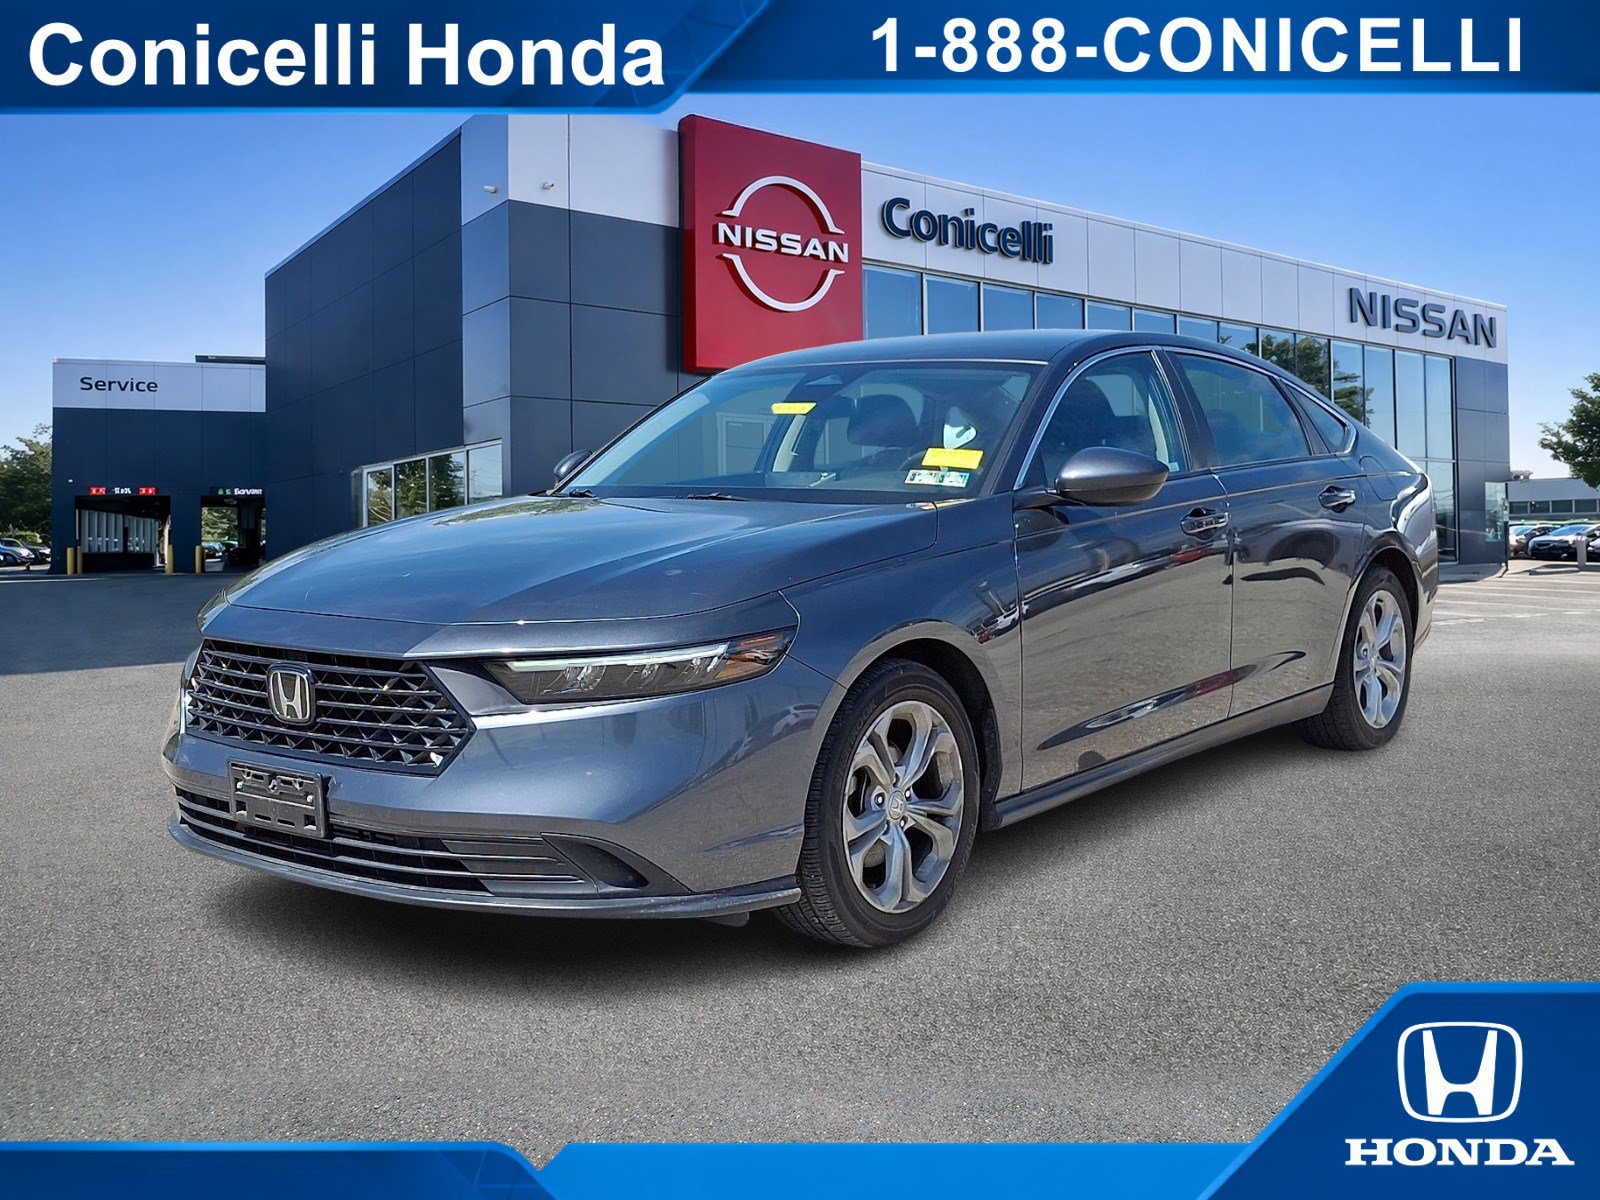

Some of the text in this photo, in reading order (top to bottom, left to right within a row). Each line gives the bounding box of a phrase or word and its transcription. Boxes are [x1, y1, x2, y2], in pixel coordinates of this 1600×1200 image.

[716, 222, 849, 263] NISSAN
[881, 197, 1054, 264] Conicelli
[1349, 287, 1497, 348] NISSAN
[80, 376, 158, 392] Service
